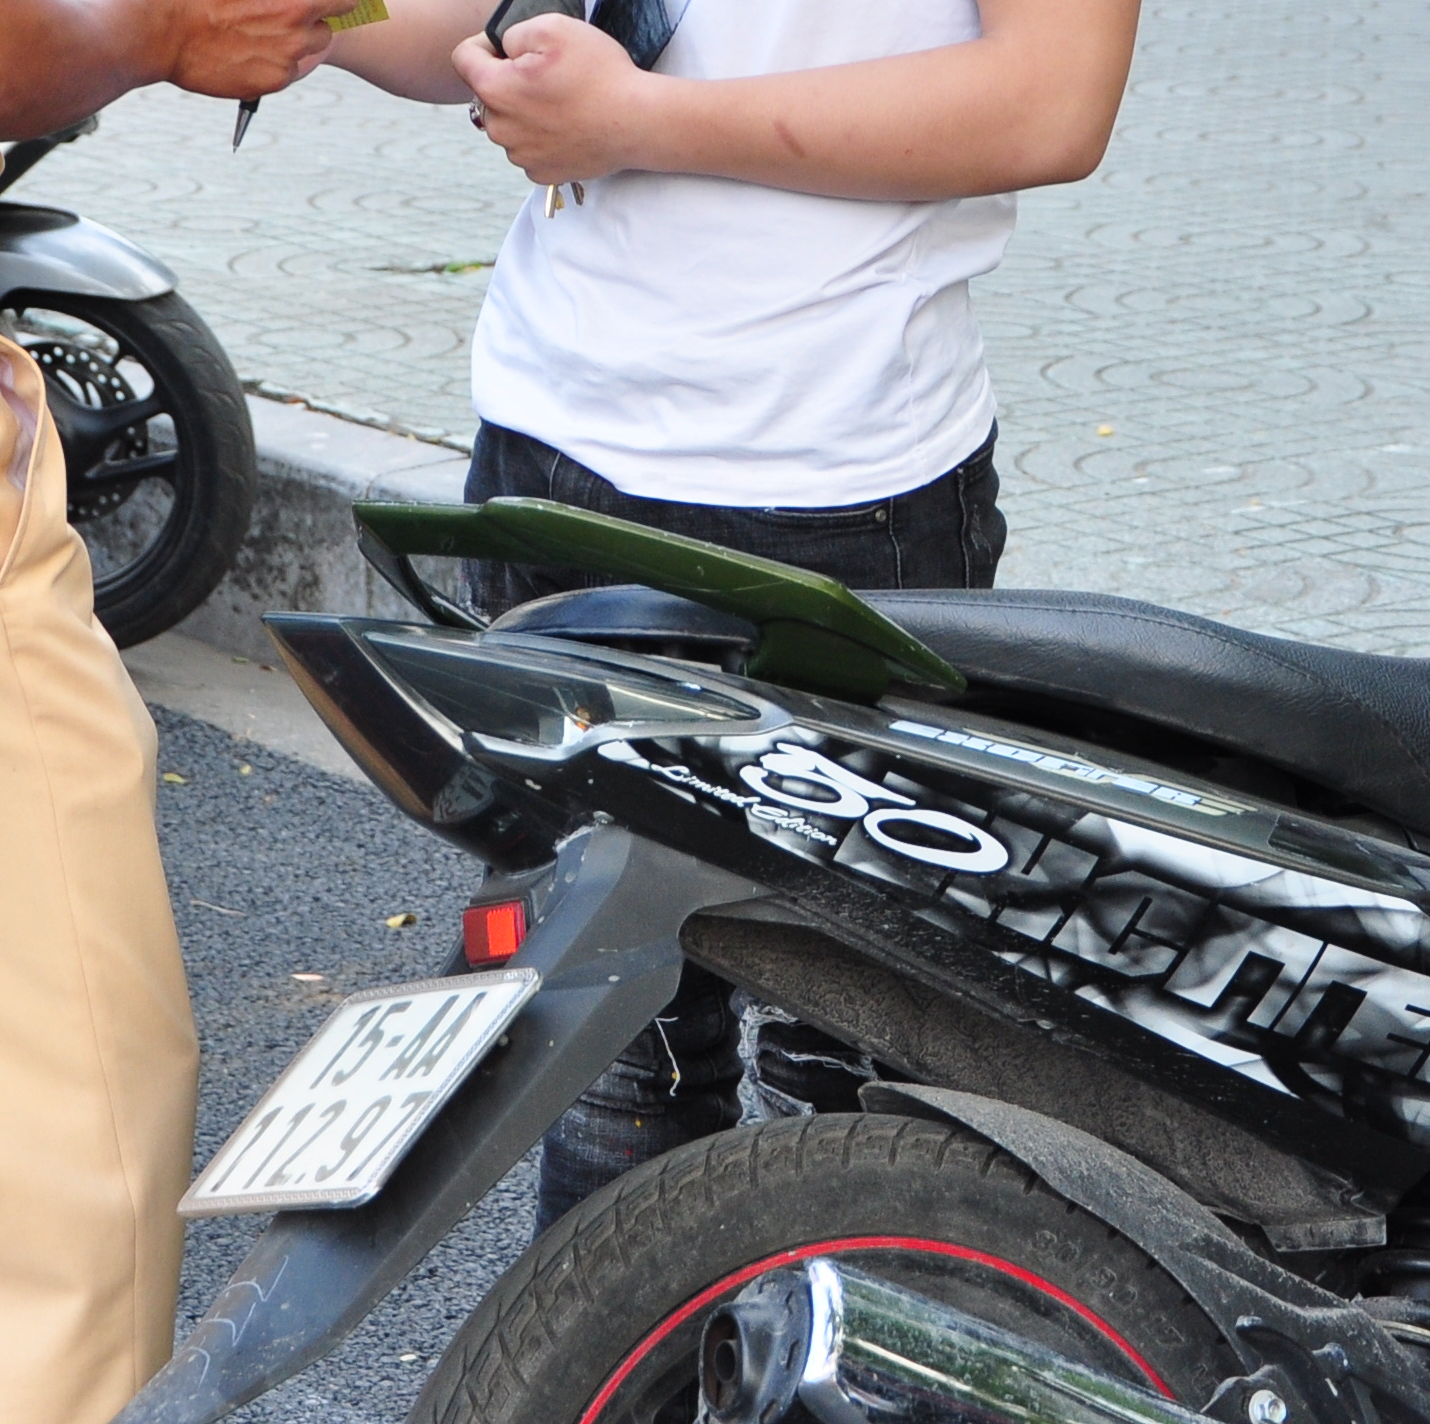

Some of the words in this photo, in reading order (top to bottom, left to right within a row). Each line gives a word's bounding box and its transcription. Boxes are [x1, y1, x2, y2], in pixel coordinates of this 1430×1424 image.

[649, 762, 761, 809] Limited
[310, 991, 487, 1090] 15-AA
[211, 1089, 435, 1193] 112.97
